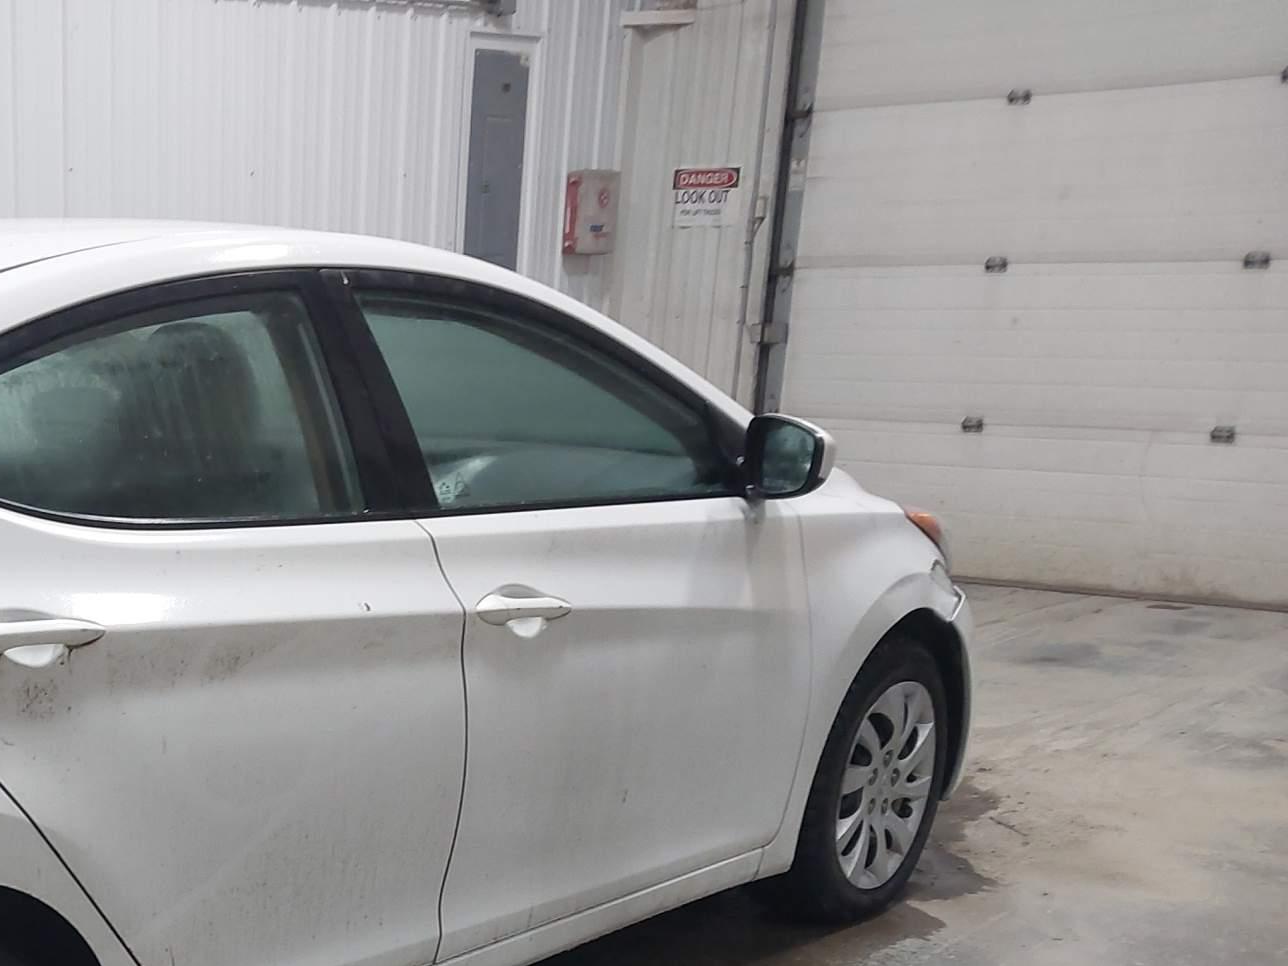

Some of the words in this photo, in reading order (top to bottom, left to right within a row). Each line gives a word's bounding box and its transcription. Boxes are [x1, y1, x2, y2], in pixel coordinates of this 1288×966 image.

[679, 172, 729, 186] DANGER
[675, 190, 706, 204] LOOK
[708, 189, 730, 204] OUT
